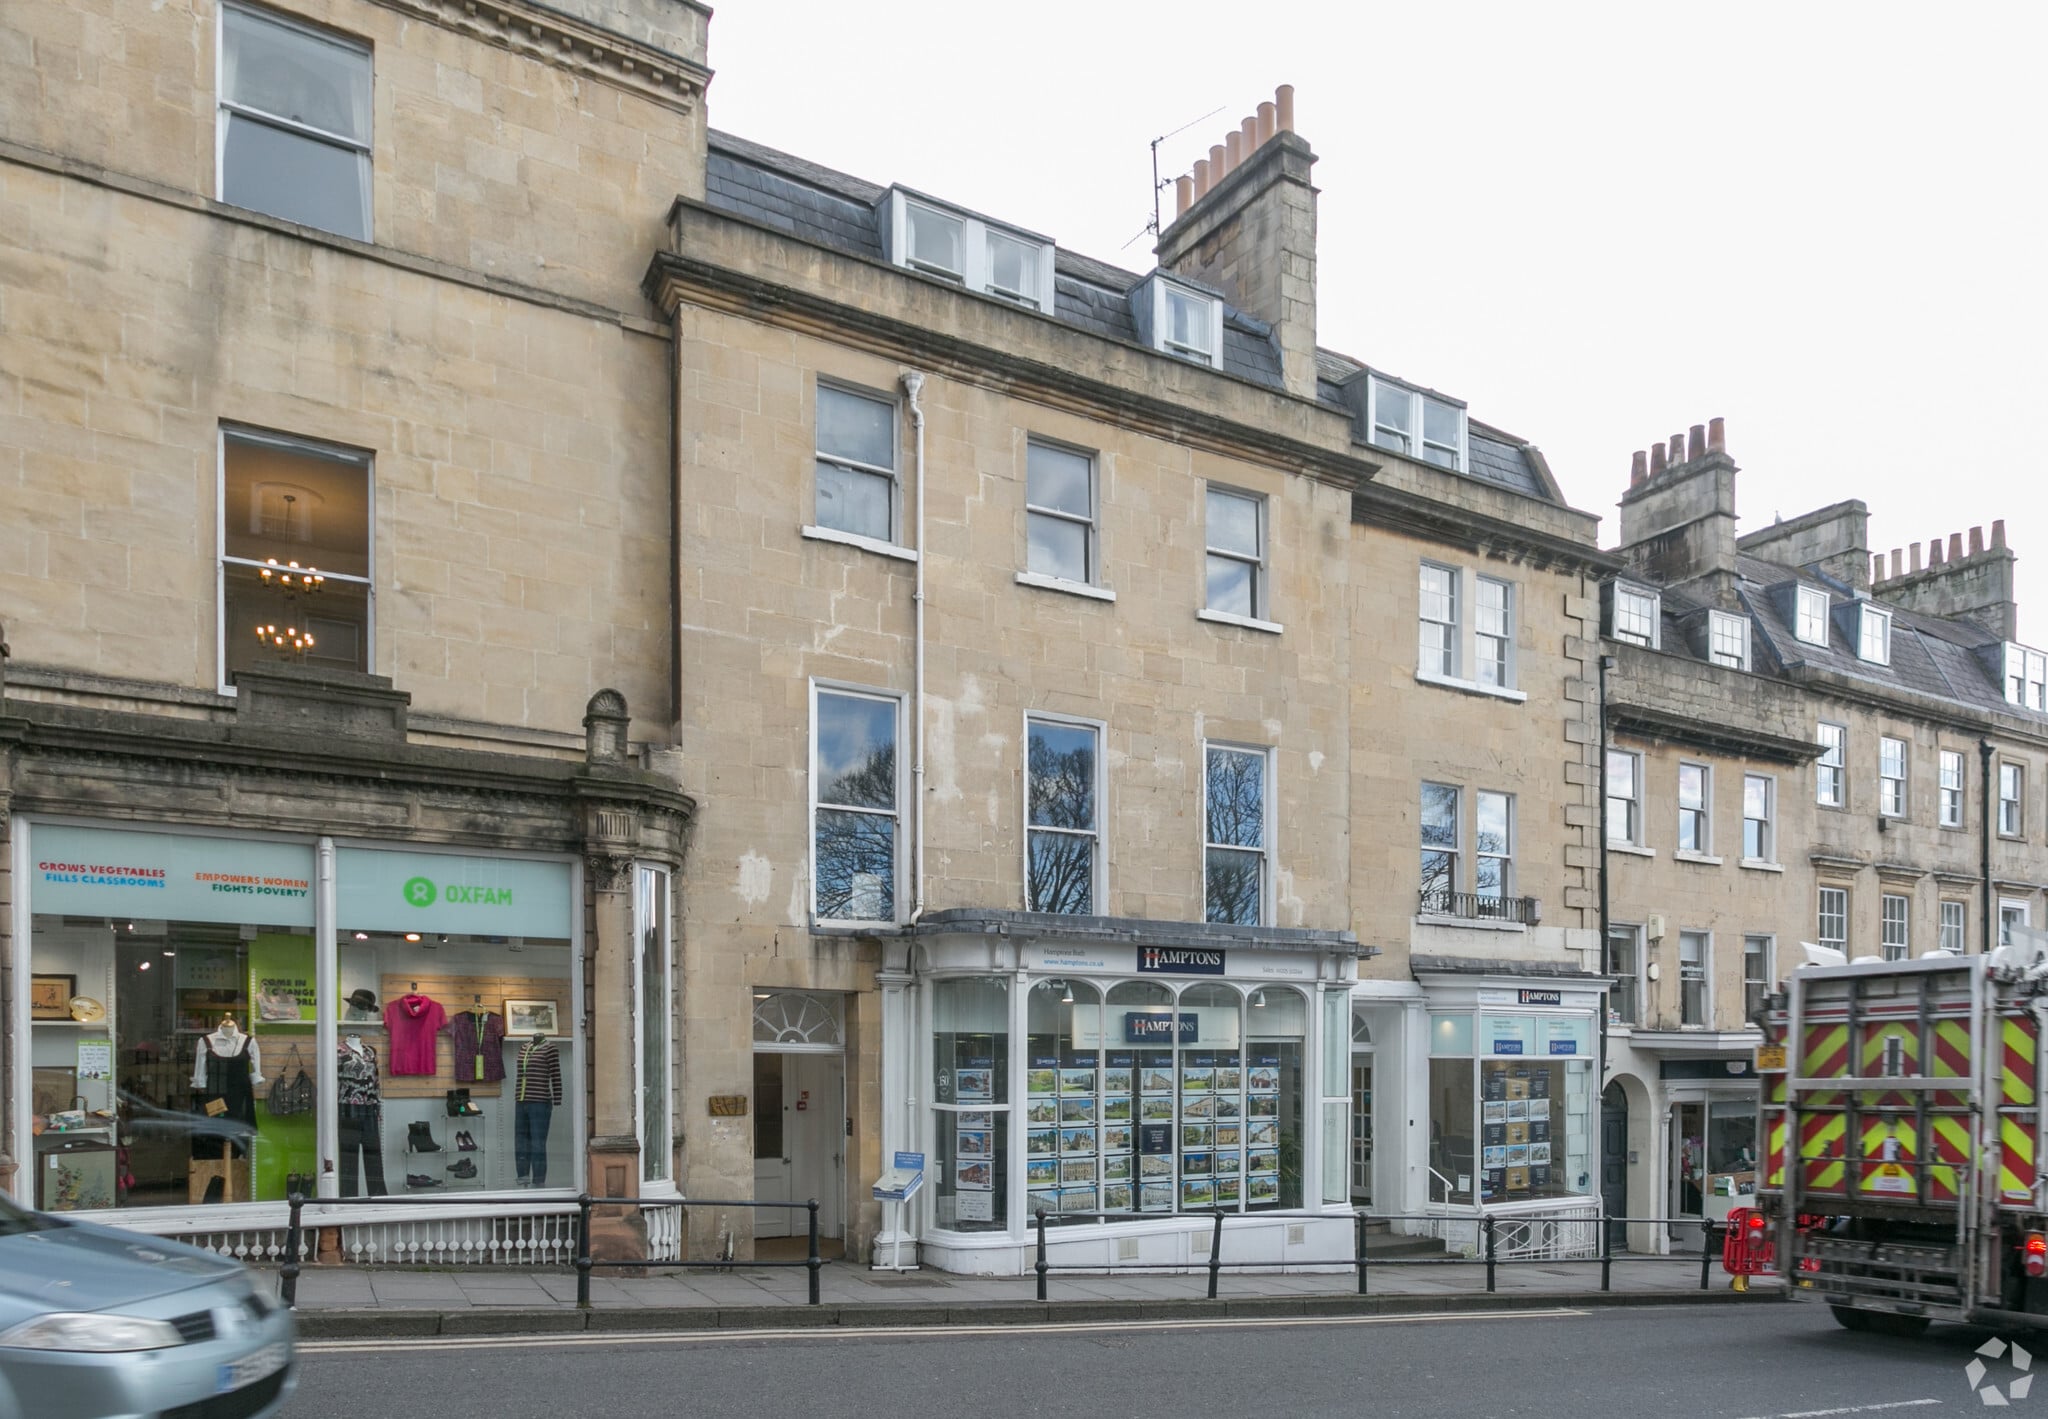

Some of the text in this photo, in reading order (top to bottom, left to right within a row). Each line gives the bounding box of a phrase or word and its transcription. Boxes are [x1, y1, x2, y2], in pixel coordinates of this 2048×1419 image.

[39, 862, 166, 878] GROWS VEGETABLES
[45, 873, 166, 888] FILLS CLASSROOMS
[195, 872, 309, 888] EMPOWERS WOMEN
[212, 883, 308, 897] FIGHTS POVERTY
[445, 885, 513, 905] OXFAM
[1144, 947, 1220, 968] HAMPTONS
[1521, 990, 1560, 1003] HAMPTONS
